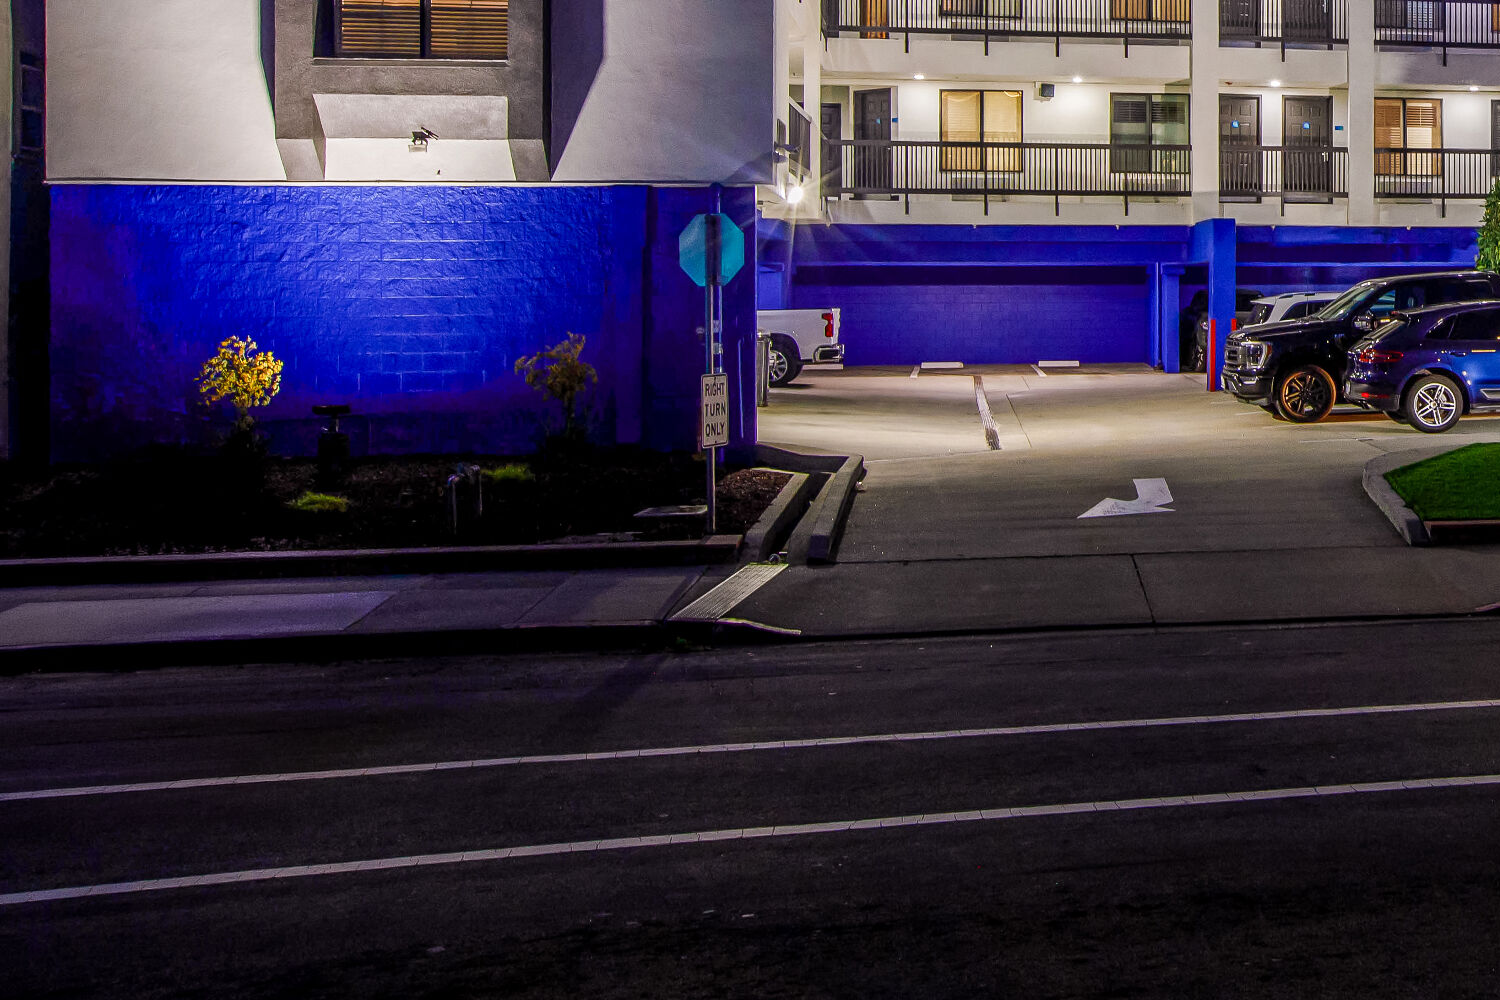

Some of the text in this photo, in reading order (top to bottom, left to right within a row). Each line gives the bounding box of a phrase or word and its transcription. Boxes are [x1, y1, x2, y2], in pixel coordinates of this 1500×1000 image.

[705, 382, 725, 397] RIGHT
[705, 402, 726, 417] TURN
[705, 422, 725, 437] ONLY
